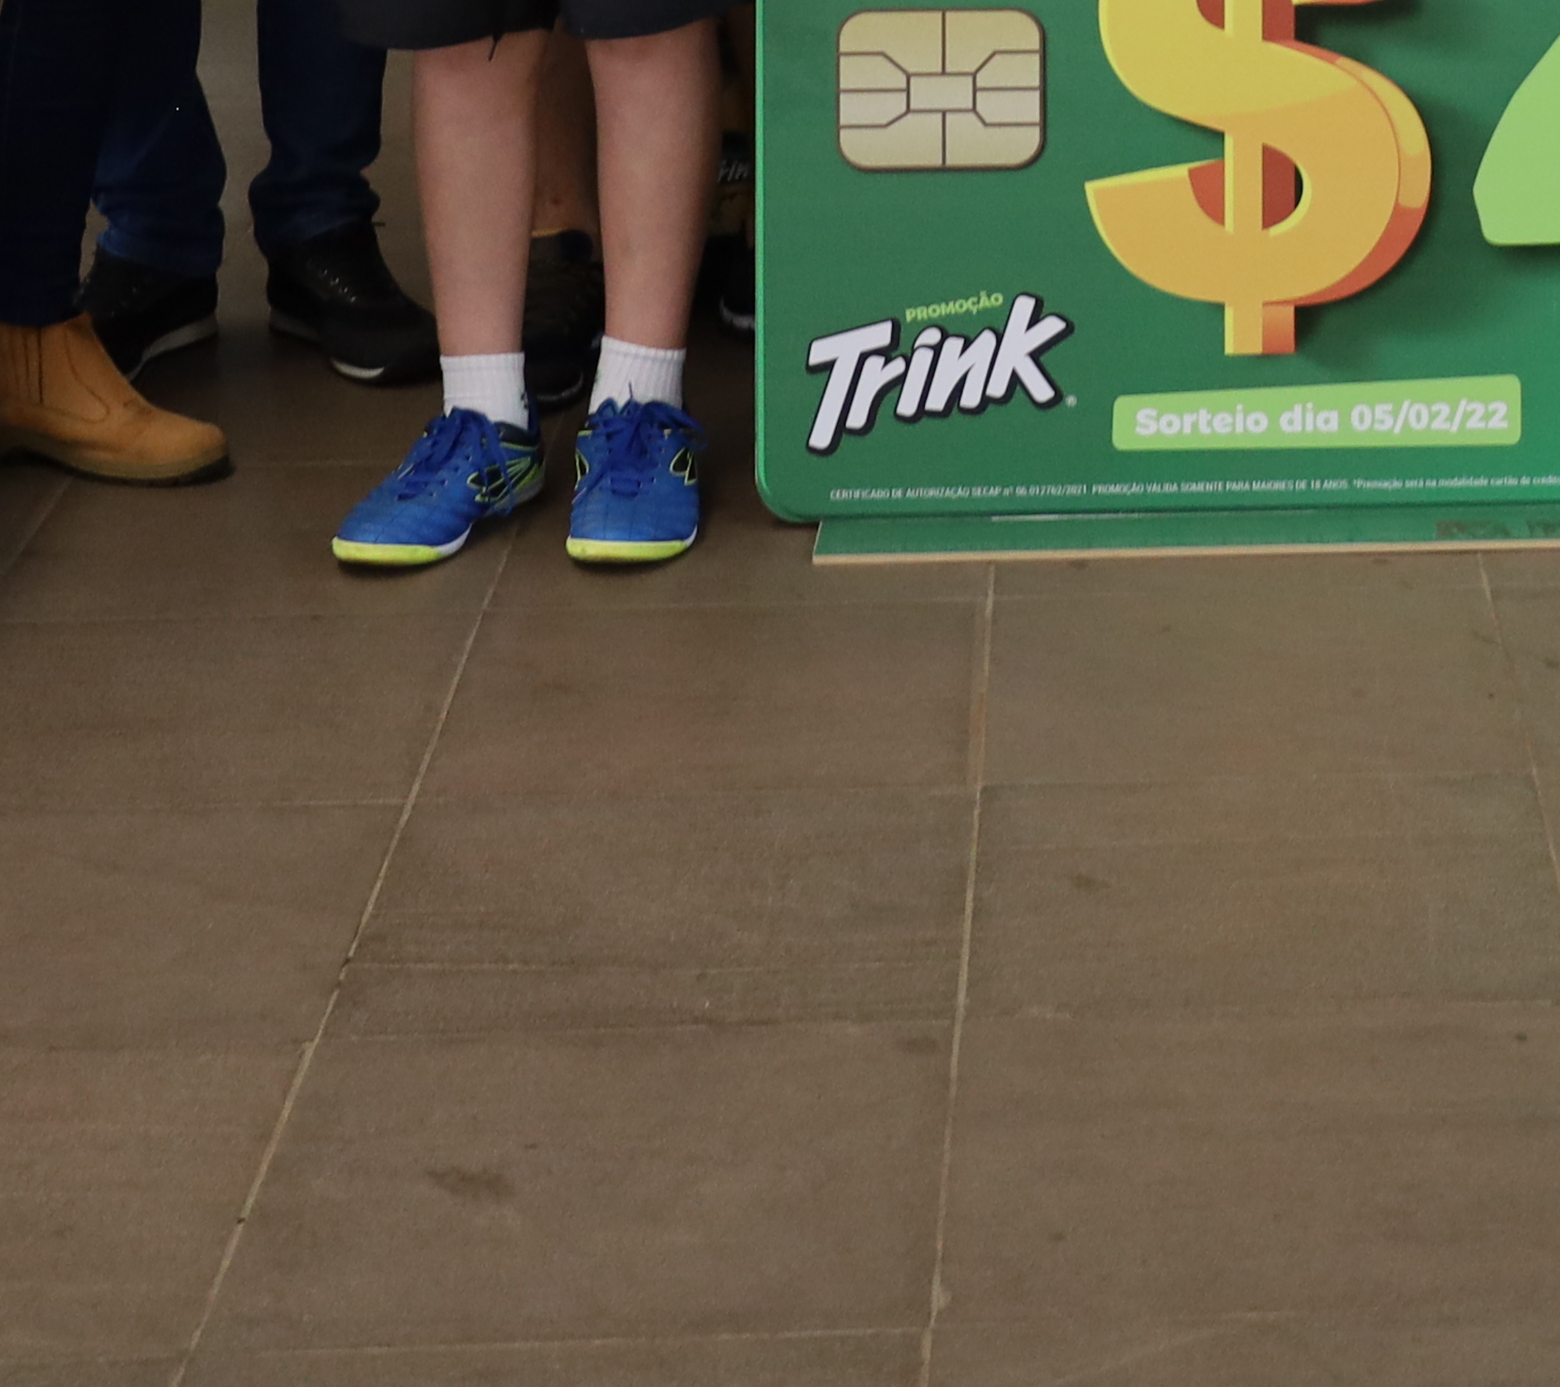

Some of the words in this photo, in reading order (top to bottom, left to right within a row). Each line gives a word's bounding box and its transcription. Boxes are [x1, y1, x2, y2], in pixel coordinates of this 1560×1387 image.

[905, 291, 1004, 324] PROMOÇÃO
[807, 293, 1069, 451] Trink
[1135, 406, 1269, 437] Sorteio
[1279, 404, 1339, 434] dia
[1350, 400, 1509, 434] 05/02/22
